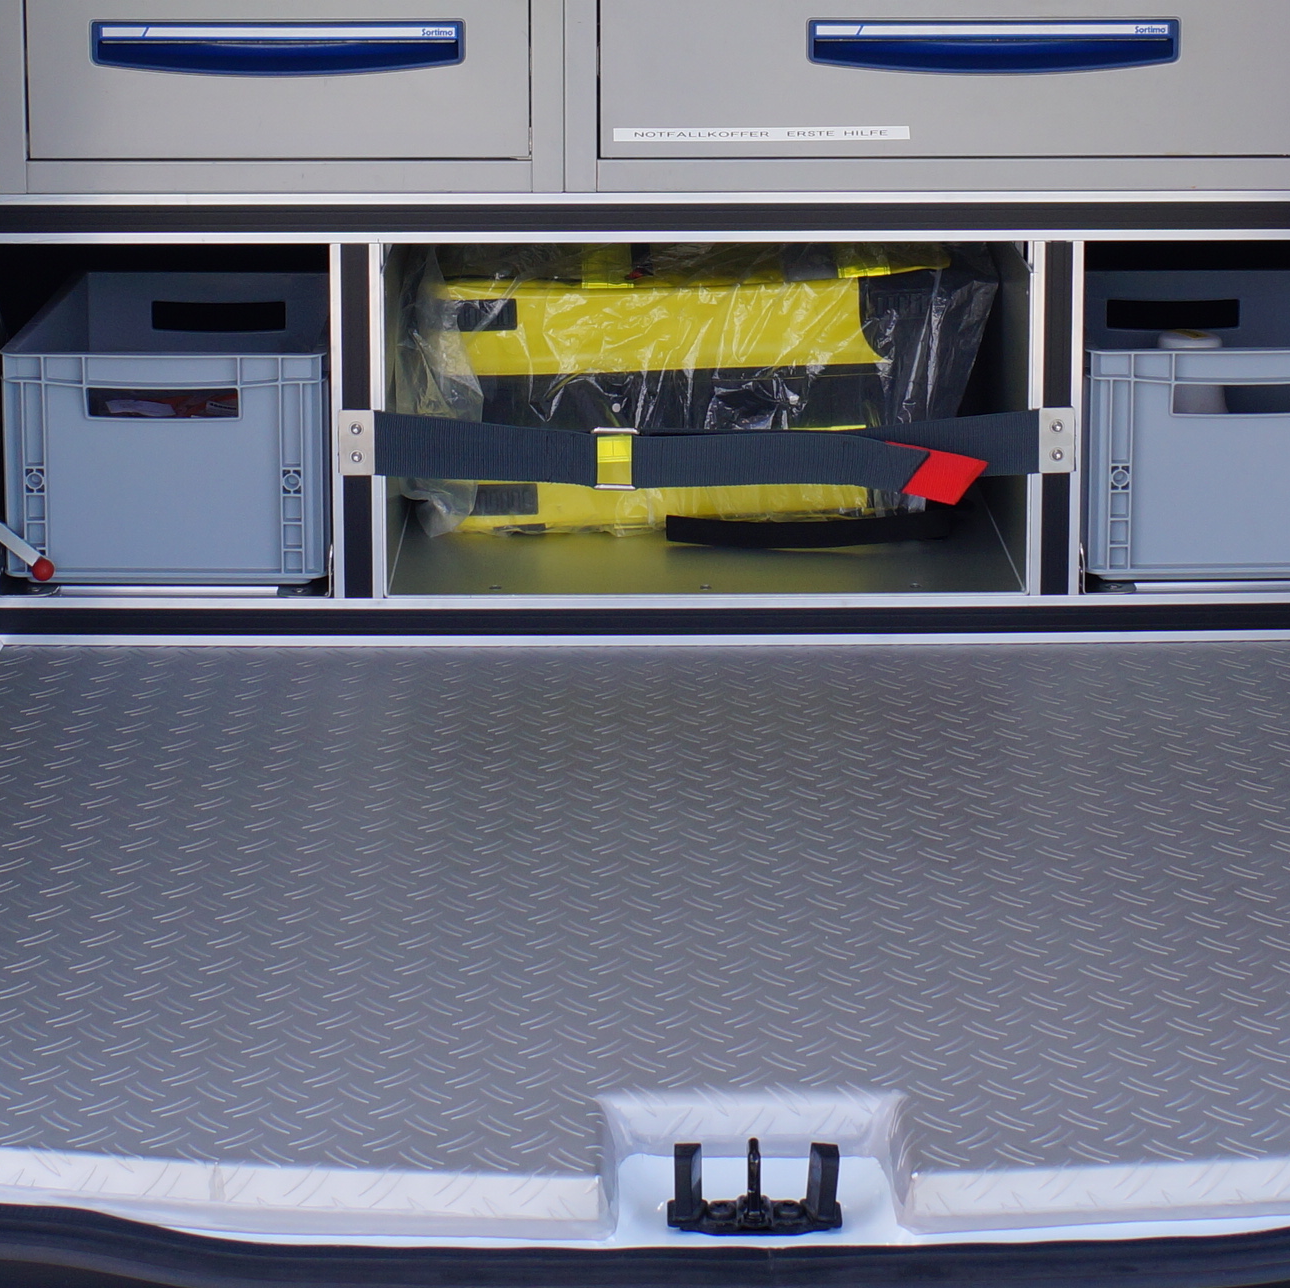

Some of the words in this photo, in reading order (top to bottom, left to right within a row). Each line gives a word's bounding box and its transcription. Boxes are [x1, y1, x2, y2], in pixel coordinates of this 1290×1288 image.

[421, 27, 454, 36] Sortimo
[1134, 25, 1167, 34] Sortimo
[633, 130, 770, 139] NOTFALLKOFFER
[786, 129, 836, 138] ERSTE
[843, 128, 889, 137] HILFE
